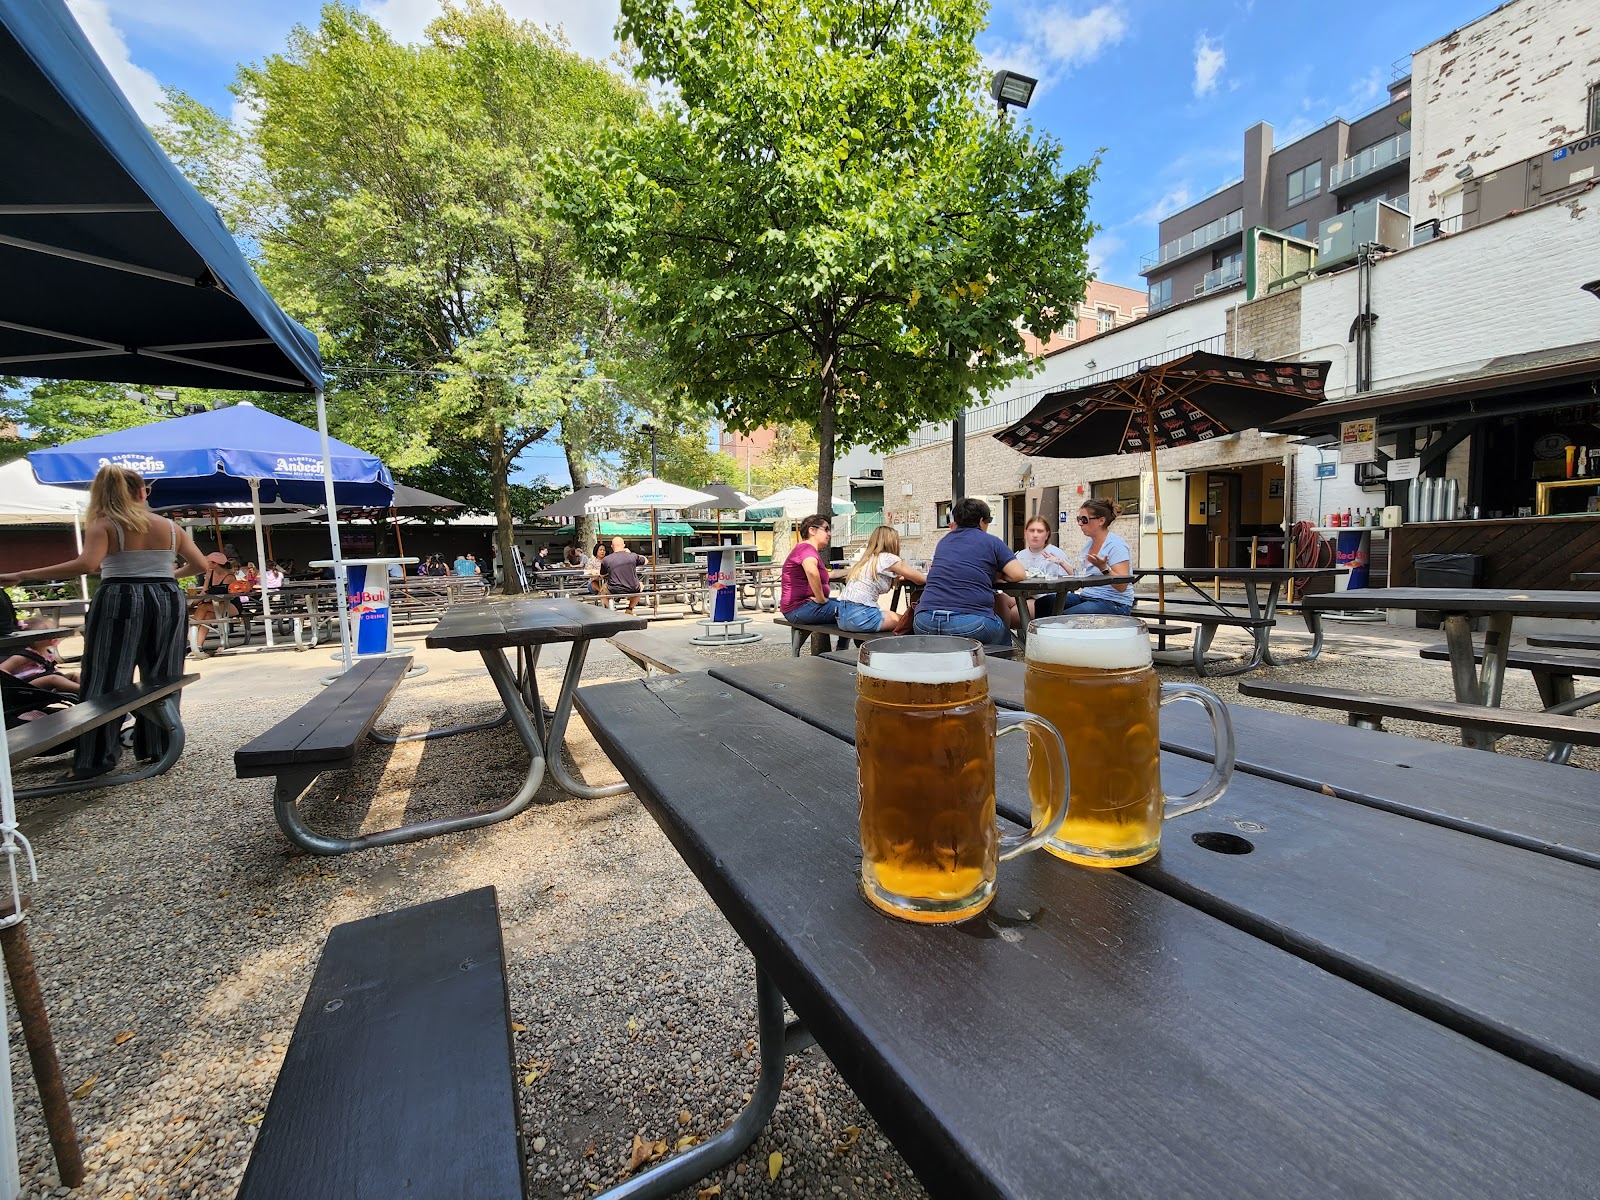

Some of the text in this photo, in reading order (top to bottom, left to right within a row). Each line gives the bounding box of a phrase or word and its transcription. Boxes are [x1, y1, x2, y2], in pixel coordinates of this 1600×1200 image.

[274, 458, 325, 475] Andech
[1336, 551, 1355, 560] Red
[718, 571, 734, 580] Bull
[347, 590, 386, 603] ed Bull
